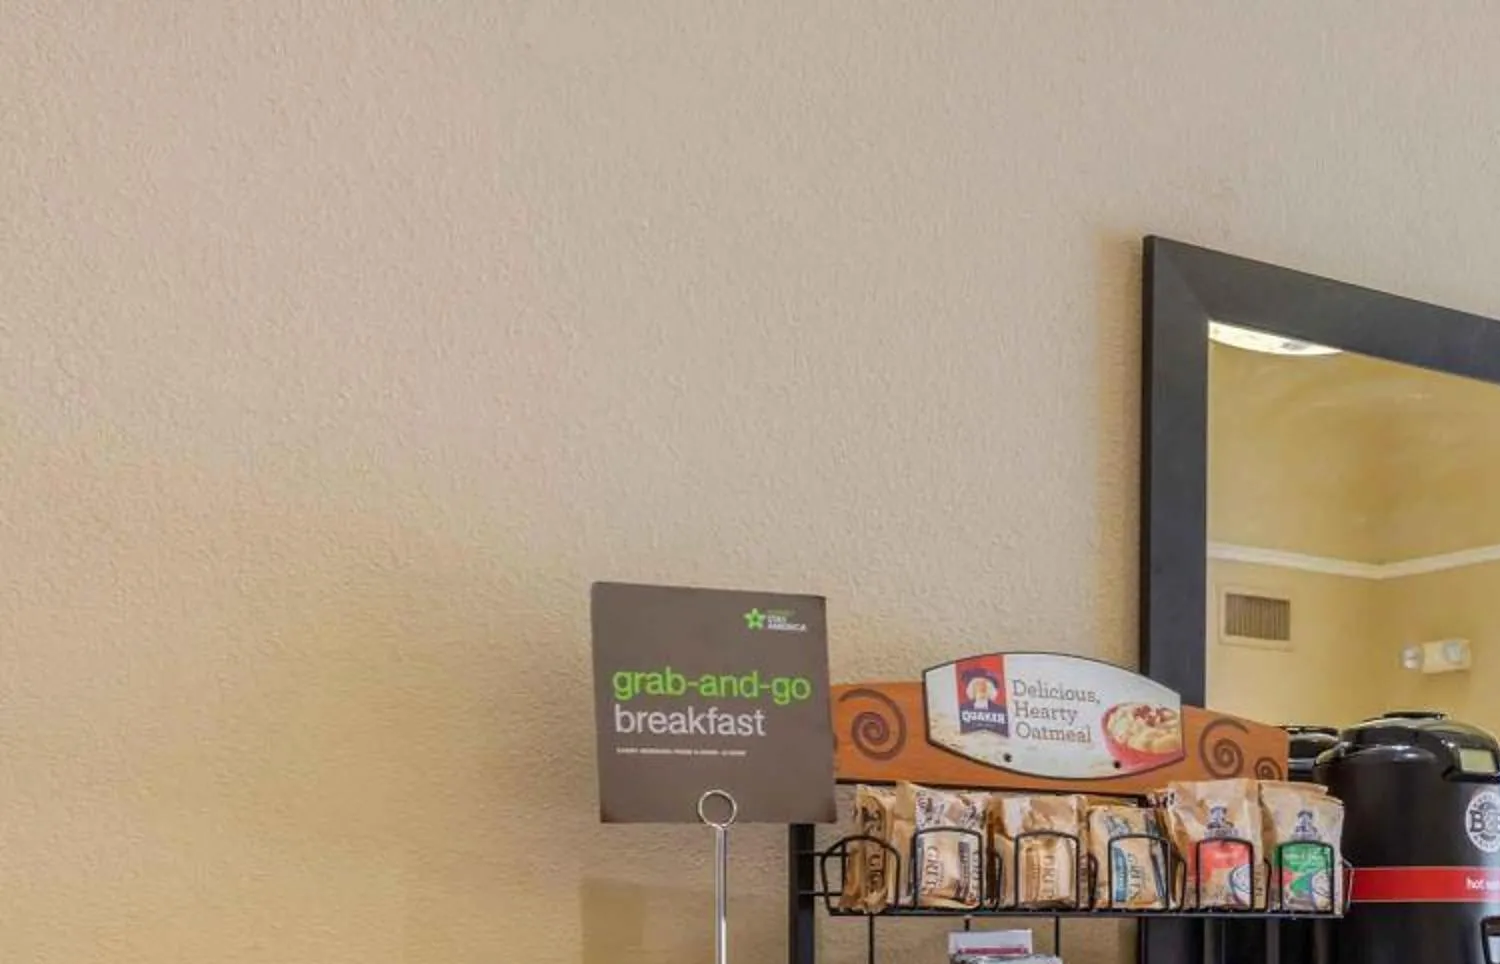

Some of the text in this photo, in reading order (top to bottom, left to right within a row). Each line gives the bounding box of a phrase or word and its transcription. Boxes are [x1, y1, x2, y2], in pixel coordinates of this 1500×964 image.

[612, 666, 811, 704] grab-and-go
[1012, 679, 1101, 704] Delicious,
[614, 703, 766, 736] breakfast
[960, 710, 1006, 725] QUAKER
[1014, 700, 1078, 726] Hearty
[1015, 721, 1092, 743] Oatmeal
[1465, 876, 1486, 891] hot
